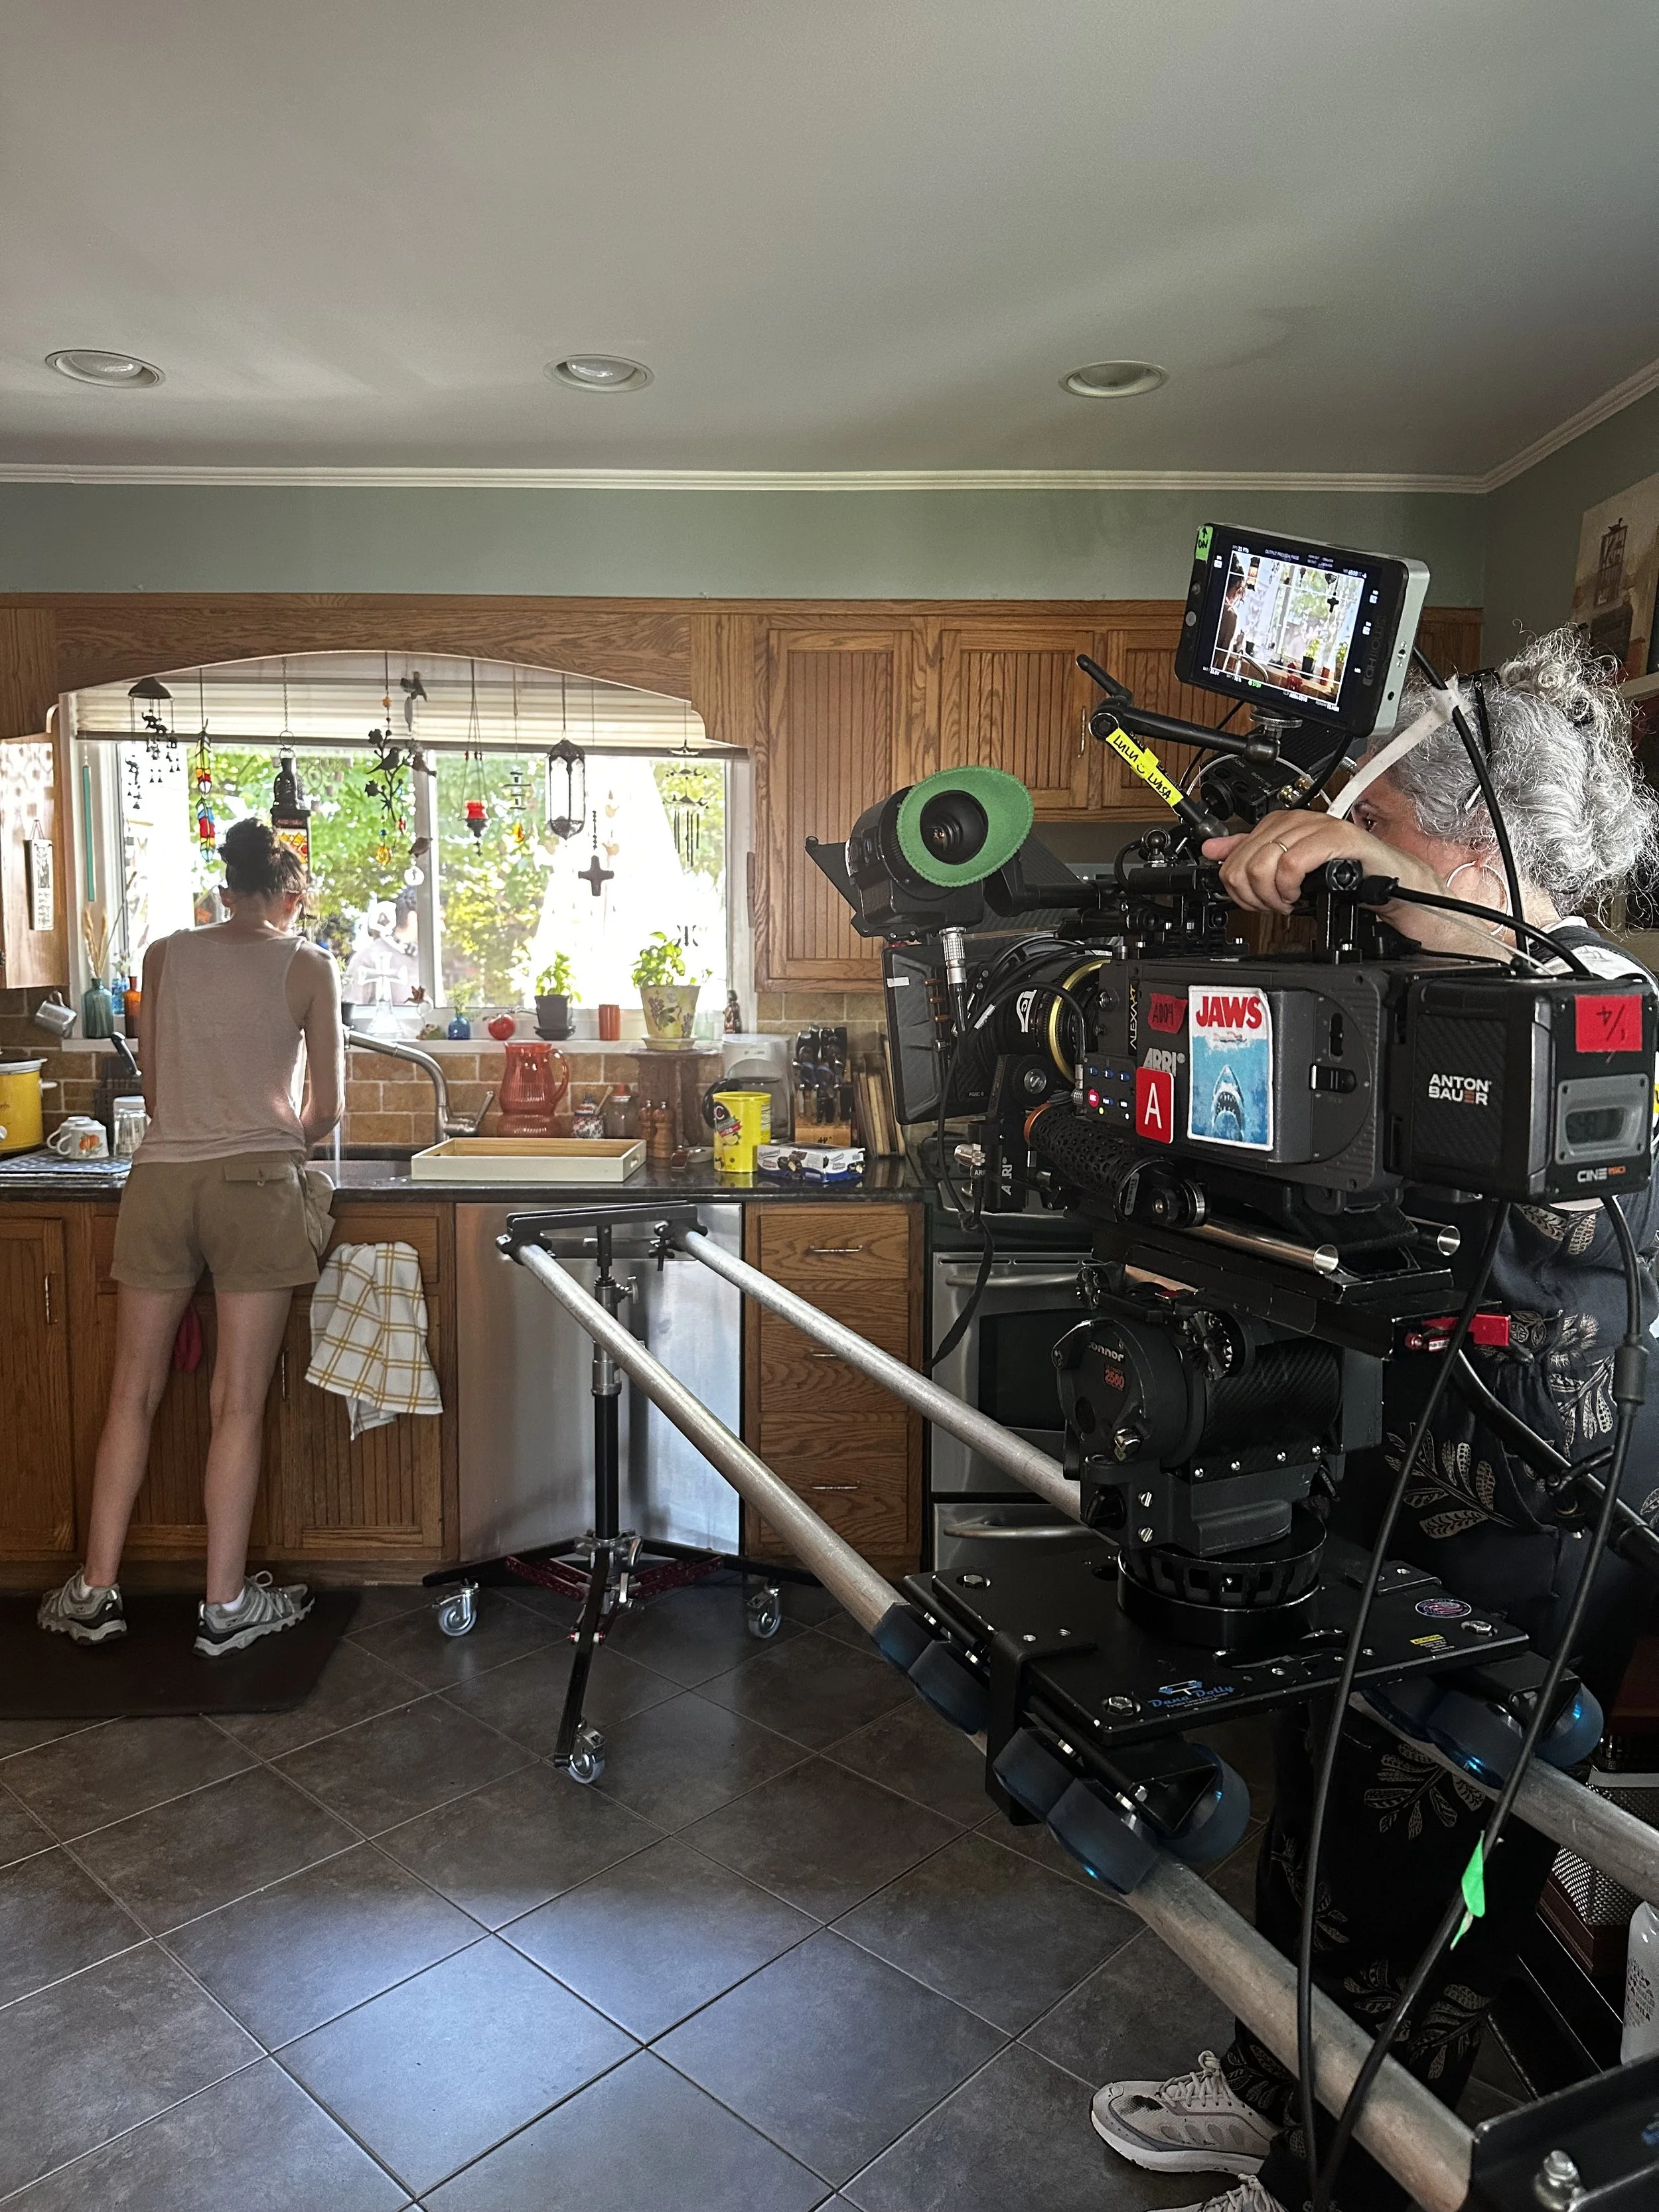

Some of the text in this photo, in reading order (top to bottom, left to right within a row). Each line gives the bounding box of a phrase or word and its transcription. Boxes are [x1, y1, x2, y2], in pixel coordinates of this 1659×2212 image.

[1198, 539, 1208, 549] ON
[1196, 995, 1262, 1029] JAWS
[1143, 1047, 1177, 1076] ARRI
[1429, 1073, 1489, 1092] ANTON
[1145, 1082, 1162, 1129] A
[1428, 1085, 1488, 1106] BAUER
[1001, 1164, 1013, 1196] ARI
[1577, 1167, 1607, 1183] CINE
[1147, 1686, 1236, 1708] Dana Dolly
